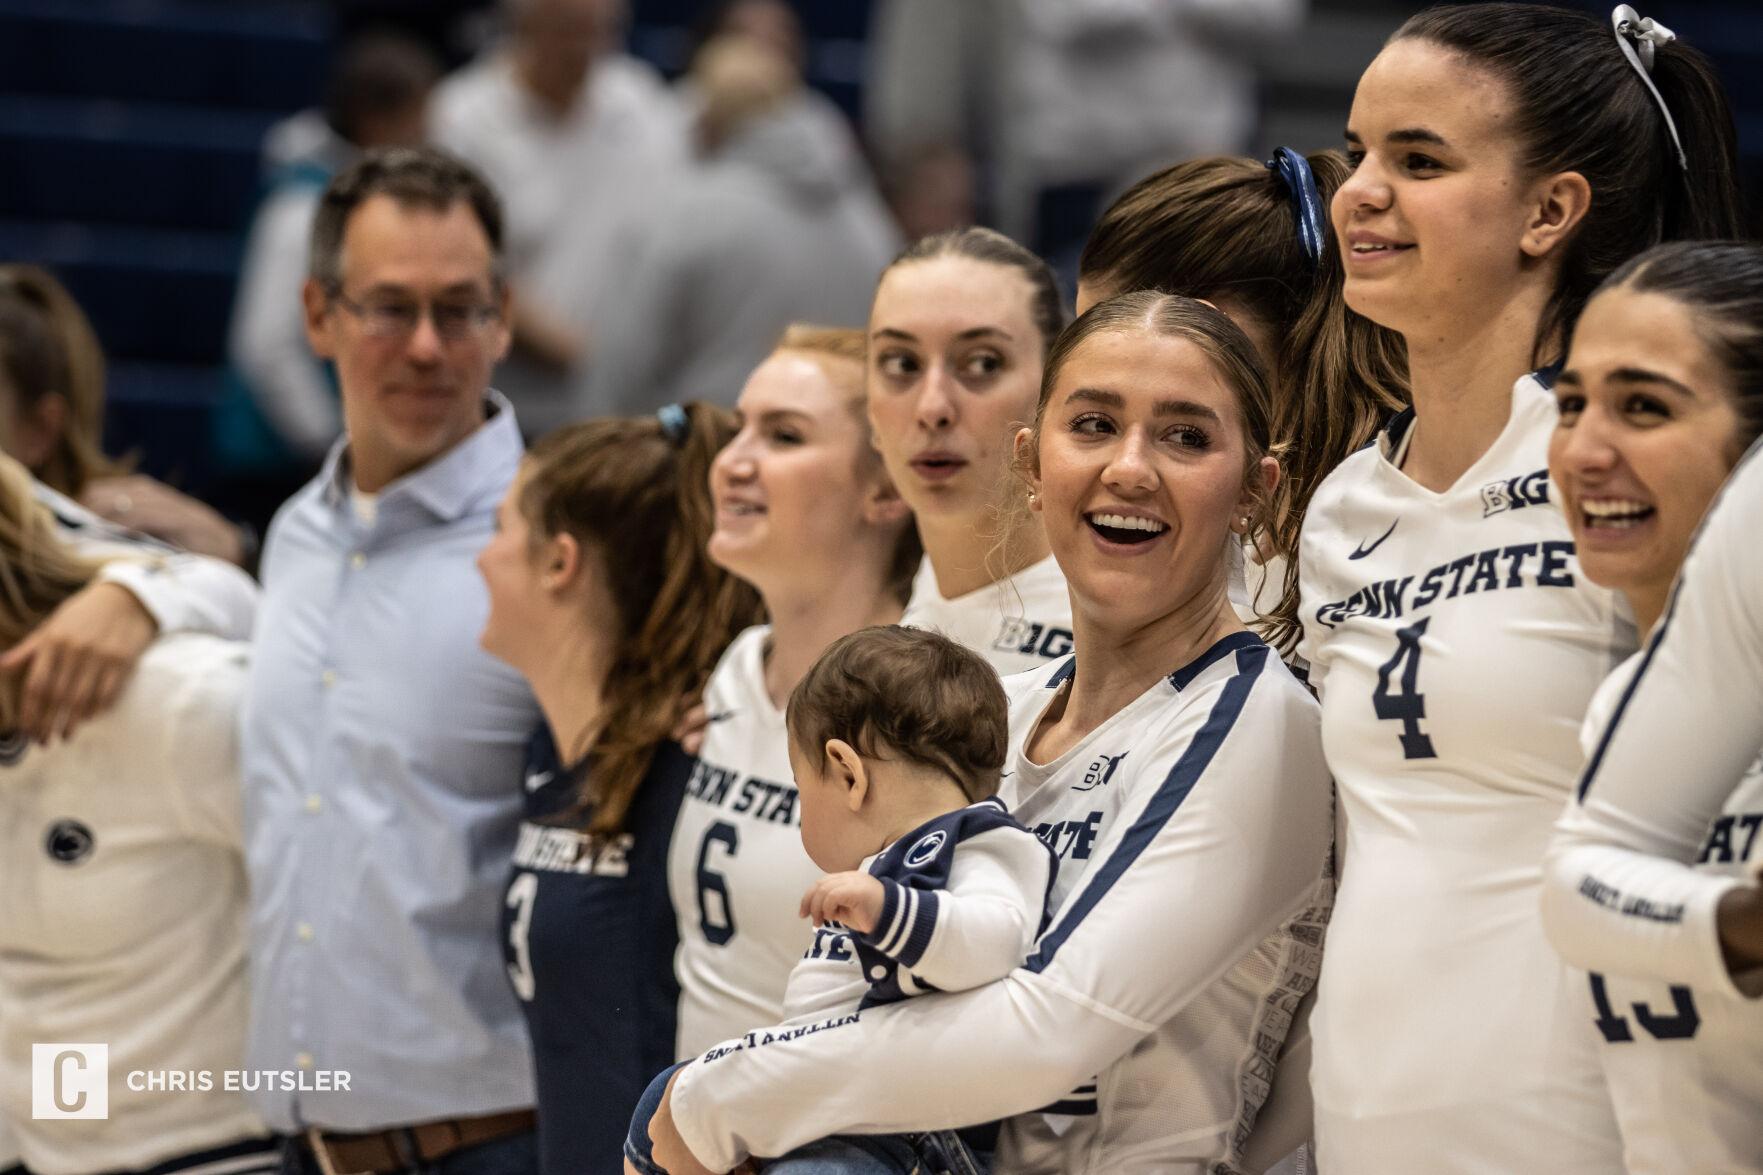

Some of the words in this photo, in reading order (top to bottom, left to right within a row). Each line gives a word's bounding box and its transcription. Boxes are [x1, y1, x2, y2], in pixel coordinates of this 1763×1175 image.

[1413, 541, 1576, 611] STATE
[1371, 616, 1439, 761] 4
[732, 775, 802, 830] STA
[697, 820, 739, 946] 6
[506, 871, 540, 1003] 3
[703, 1032, 758, 1064] LNS
